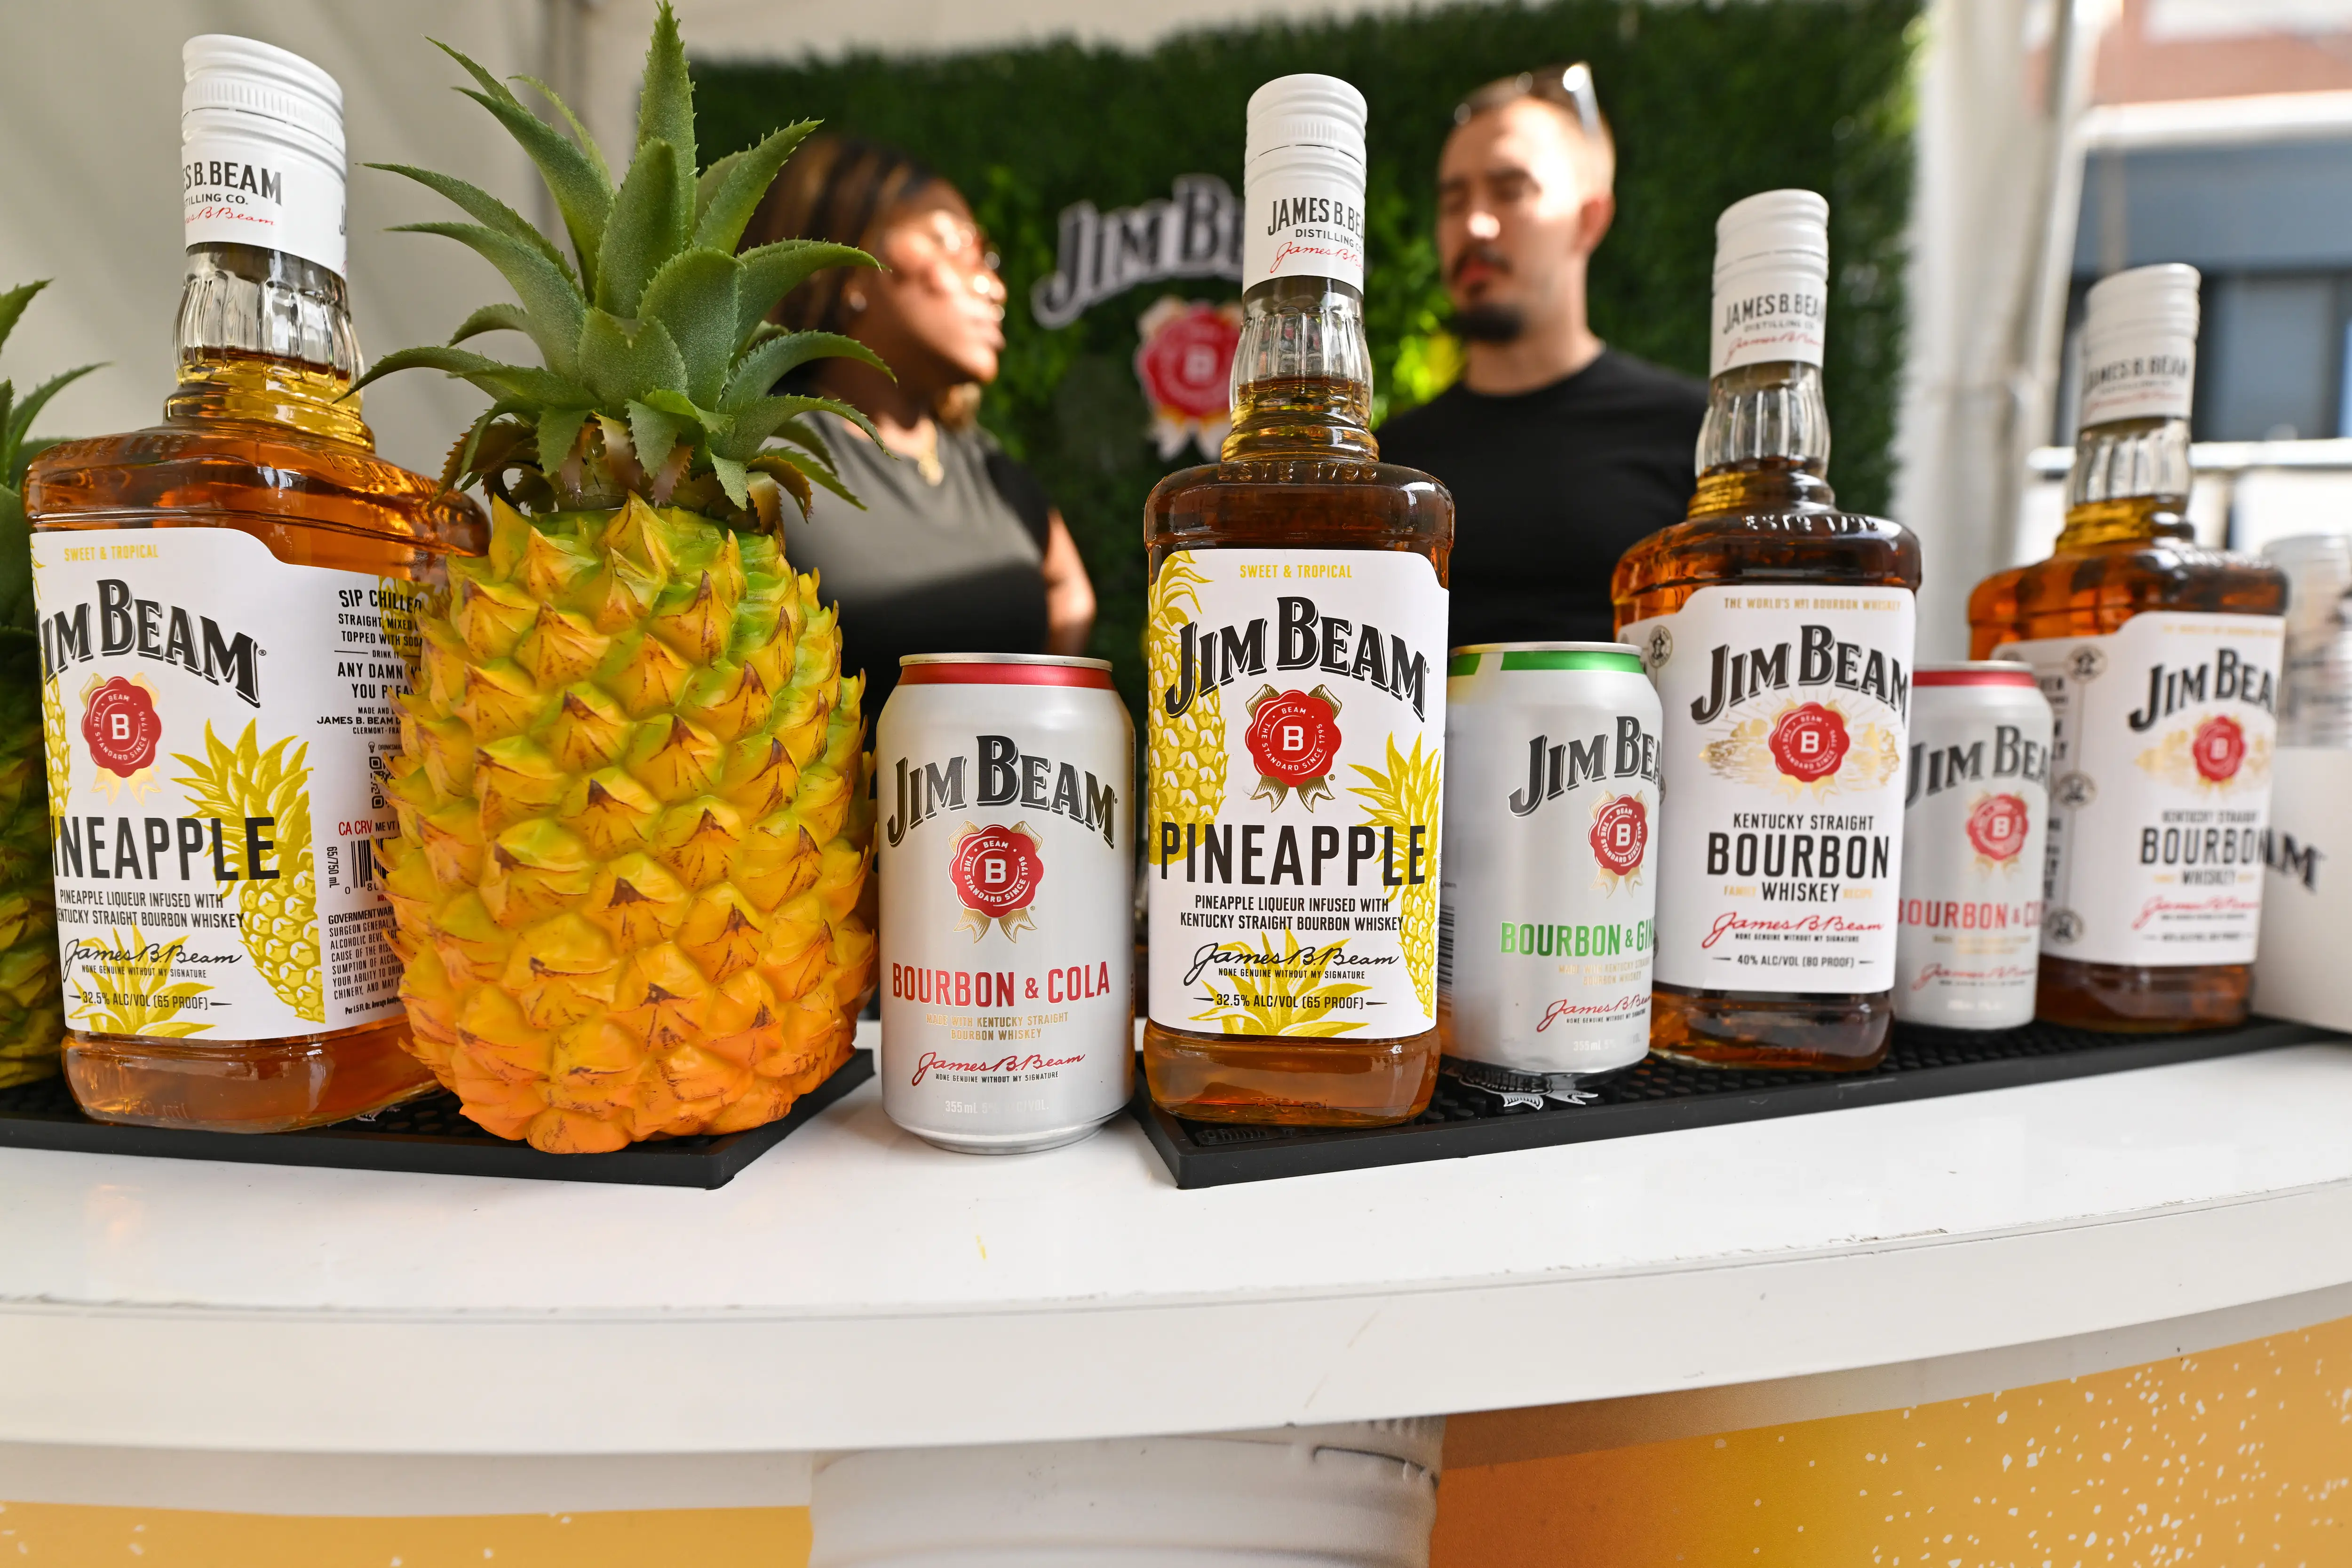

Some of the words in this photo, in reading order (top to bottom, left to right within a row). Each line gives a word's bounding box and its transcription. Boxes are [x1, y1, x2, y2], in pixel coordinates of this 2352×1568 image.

[226, 194, 248, 205] CO.
[1268, 197, 1329, 236] JAMES
[1295, 229, 1354, 247] DISTILLING
[64, 547, 95, 561] SWEET
[100, 547, 106, 560] &
[111, 545, 158, 559] TROPICAL
[1240, 565, 1278, 578] SWEET
[1284, 565, 1292, 578] &
[1298, 565, 1352, 578] TROPICAL
[339, 589, 363, 608] SIP
[1724, 598, 1741, 609] THE
[1747, 598, 1790, 610] WORLD'S
[1813, 599, 1858, 610] BOURBON
[338, 613, 384, 629] STRAIGHT,
[387, 618, 412, 631] MIXED
[96, 579, 261, 708] BEAM
[342, 631, 375, 643] TOPPED
[379, 634, 400, 646] WITH
[373, 650, 391, 658] DRINK
[1165, 618, 1267, 719] JIM
[1276, 596, 1425, 723] BEAM
[338, 662, 363, 677] ANY
[369, 663, 403, 679] DAMN
[1690, 642, 1791, 724] JIM
[1798, 625, 1908, 729] BEAM
[351, 683, 375, 699] YOU
[2128, 663, 2209, 732] JIM
[111, 714, 130, 739] B
[317, 716, 353, 725] JAMES
[1261, 723, 1271, 739] THE
[1283, 726, 1303, 751] B
[1317, 724, 1325, 744] 1795
[95, 732, 128, 760] STANDARD
[130, 736, 147, 758] SINCE
[1800, 731, 1819, 753] B
[1262, 743, 1299, 770] STANDARD
[1302, 748, 1323, 768] SINCE
[1509, 734, 1609, 818] JIM
[1905, 739, 1987, 810] JIM
[887, 755, 968, 847] JIM
[976, 735, 1115, 849] BEAM
[339, 821, 352, 836] CA
[354, 820, 373, 835] CRV
[1733, 813, 1804, 830] KENTUCKY
[1811, 815, 1874, 832] STRAIGHT
[1616, 824, 1630, 846] B
[1161, 822, 1425, 886] PINEAPPLE
[1707, 832, 1889, 879] BOURBON
[964, 855, 974, 872] THE
[985, 858, 1006, 883] B
[964, 875, 1002, 903] STANDARD
[1006, 879, 1026, 900] SINCE
[1762, 882, 1840, 903] WHISKEY
[60, 889, 104, 905] PINEAPPLE
[107, 892, 146, 908] LIQUEUR
[150, 893, 191, 908] INFUSED
[196, 894, 223, 908] WITH
[1195, 895, 1254, 911] PINEAPPLE
[1259, 897, 1305, 913] LIQUEUR
[1309, 897, 1356, 912] INFUSED
[1360, 897, 1389, 912] WITH
[93, 911, 137, 926] STRAIGHT
[141, 912, 187, 927] BOURBON
[191, 913, 245, 928] WHISKEY
[328, 908, 376, 925] GOVERNMENT
[1180, 913, 1234, 930] KENTUCKY
[1238, 916, 1292, 931] STRAIGHT
[1297, 916, 1350, 932] BOURBON
[1355, 916, 1404, 932] WHISKEY
[329, 925, 361, 937] SURGEON
[1501, 922, 1621, 957] BOURBON
[1625, 928, 1634, 948] &
[331, 935, 366, 950] ALCOHOLIC
[332, 950, 352, 962] CAUSE
[366, 947, 376, 957] THE
[1738, 955, 1758, 966] 40%
[1761, 955, 1799, 967] ALC/VOL
[1803, 957, 1818, 967] (80
[1821, 957, 1854, 968] PROOF)
[82, 964, 97, 974] NONE
[99, 965, 125, 975] GENUINE
[128, 967, 155, 976] WITHOUT
[158, 968, 167, 977] MY
[170, 968, 207, 978] SIGNATURE
[332, 960, 366, 975] SUMPTION
[1218, 968, 1238, 977] NONE
[1240, 968, 1271, 978] GENUINE
[1274, 969, 1308, 979] WITHOUT
[1311, 969, 1322, 979] MY
[1324, 970, 1366, 980] SIGNATURE
[333, 975, 351, 987] YOUR
[354, 970, 376, 985] ABILITY
[893, 962, 1015, 1008] BOURBON
[1025, 977, 1040, 999] &
[1047, 961, 1110, 1005] COLA
[334, 987, 364, 1000] CHINERY,
[367, 982, 379, 993] AND
[382, 978, 394, 990] MAY
[82, 991, 110, 1005] 32.5%
[113, 993, 151, 1007] ALC/VOL
[153, 996, 169, 1008] (65
[172, 996, 208, 1010] PROOF)
[1216, 994, 1250, 1006] 32.5%
[1253, 996, 1298, 1008] ALC/VOL
[1302, 996, 1321, 1009] (65
[1324, 996, 1364, 1010] PROOF)
[926, 1013, 948, 1026] MADE
[951, 1015, 973, 1027] WITH
[977, 1016, 1024, 1028] KENTUCKY
[1027, 1012, 1069, 1026] STRAIGHT
[951, 1029, 994, 1041] BOURBON
[998, 1028, 1042, 1041] WHISKEY
[936, 1073, 951, 1082] NONE
[952, 1075, 978, 1083] GENUINE
[1012, 1074, 1022, 1083] MY
[1025, 1070, 1059, 1081] SIGNATURE
[945, 1101, 963, 1114] 355
